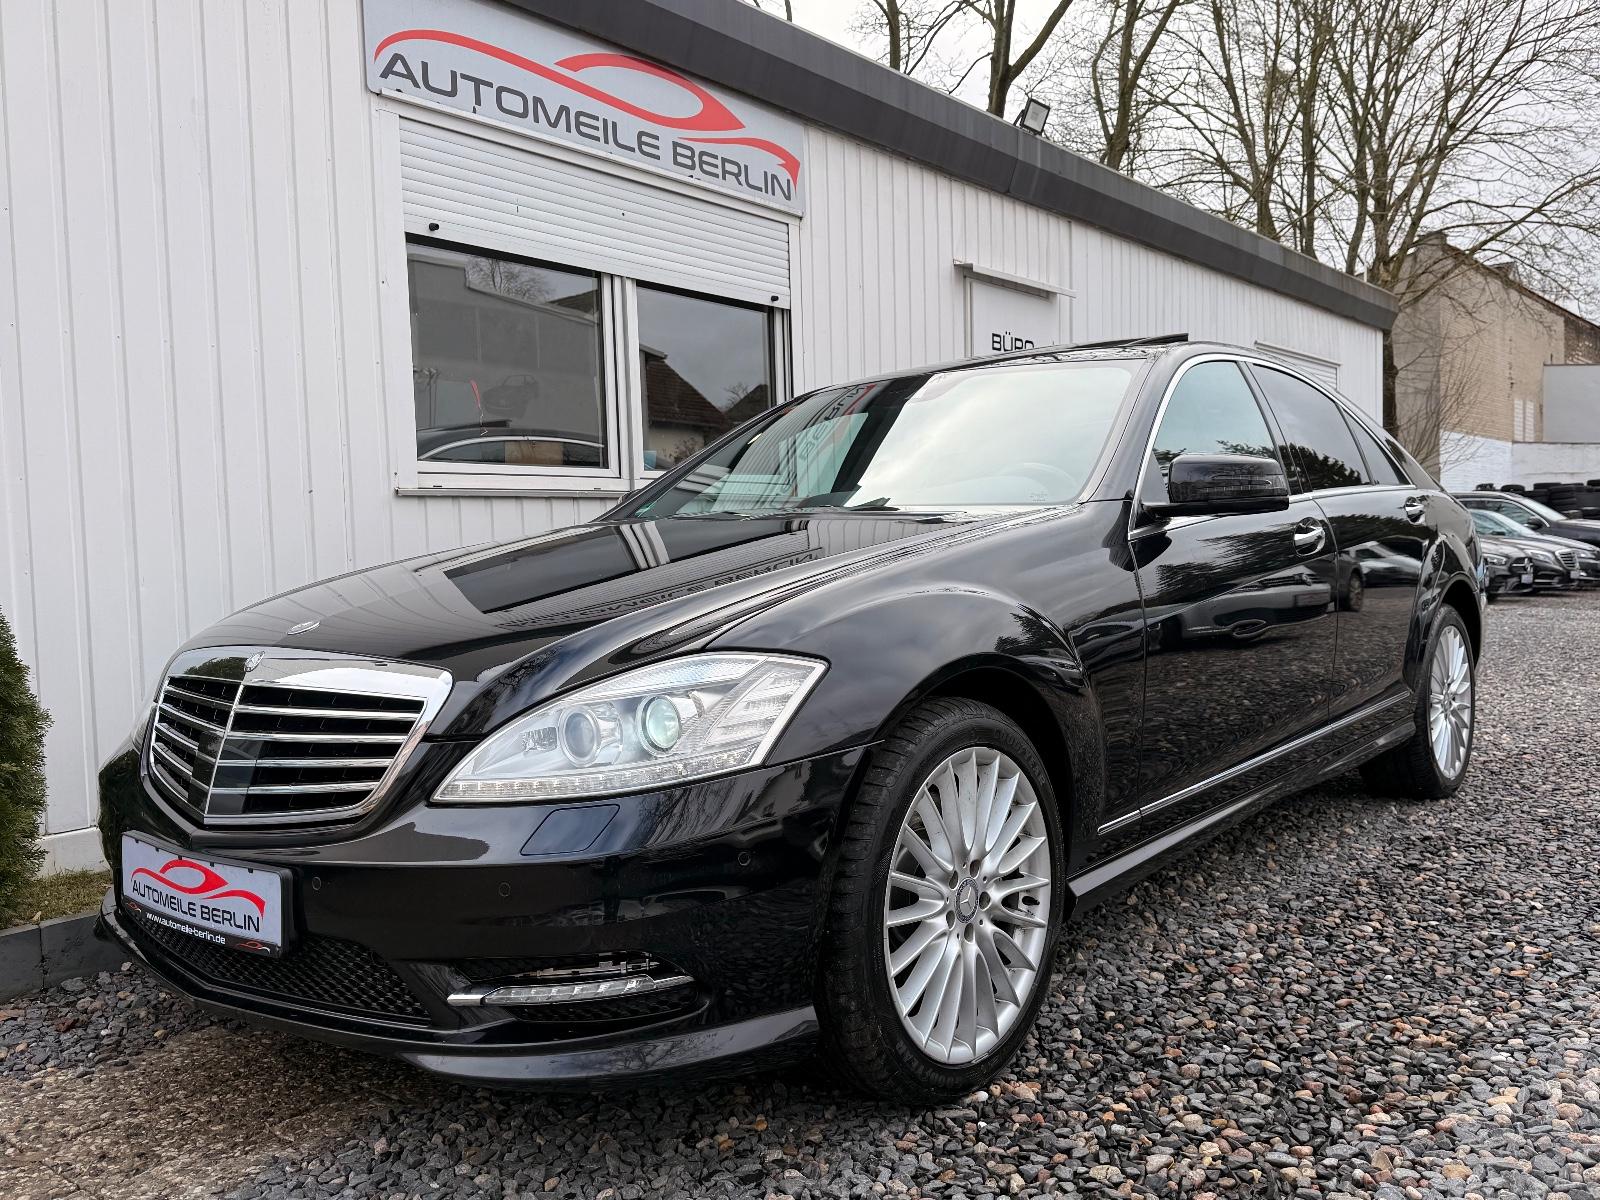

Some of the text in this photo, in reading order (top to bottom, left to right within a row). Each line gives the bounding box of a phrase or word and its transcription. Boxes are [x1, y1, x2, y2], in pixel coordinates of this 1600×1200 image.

[379, 52, 792, 201] AUTOMEILE BERLIN
[131, 878, 260, 933] AUTOMEILE BERLIN
[146, 911, 226, 945] www.automeile-berlin.de
